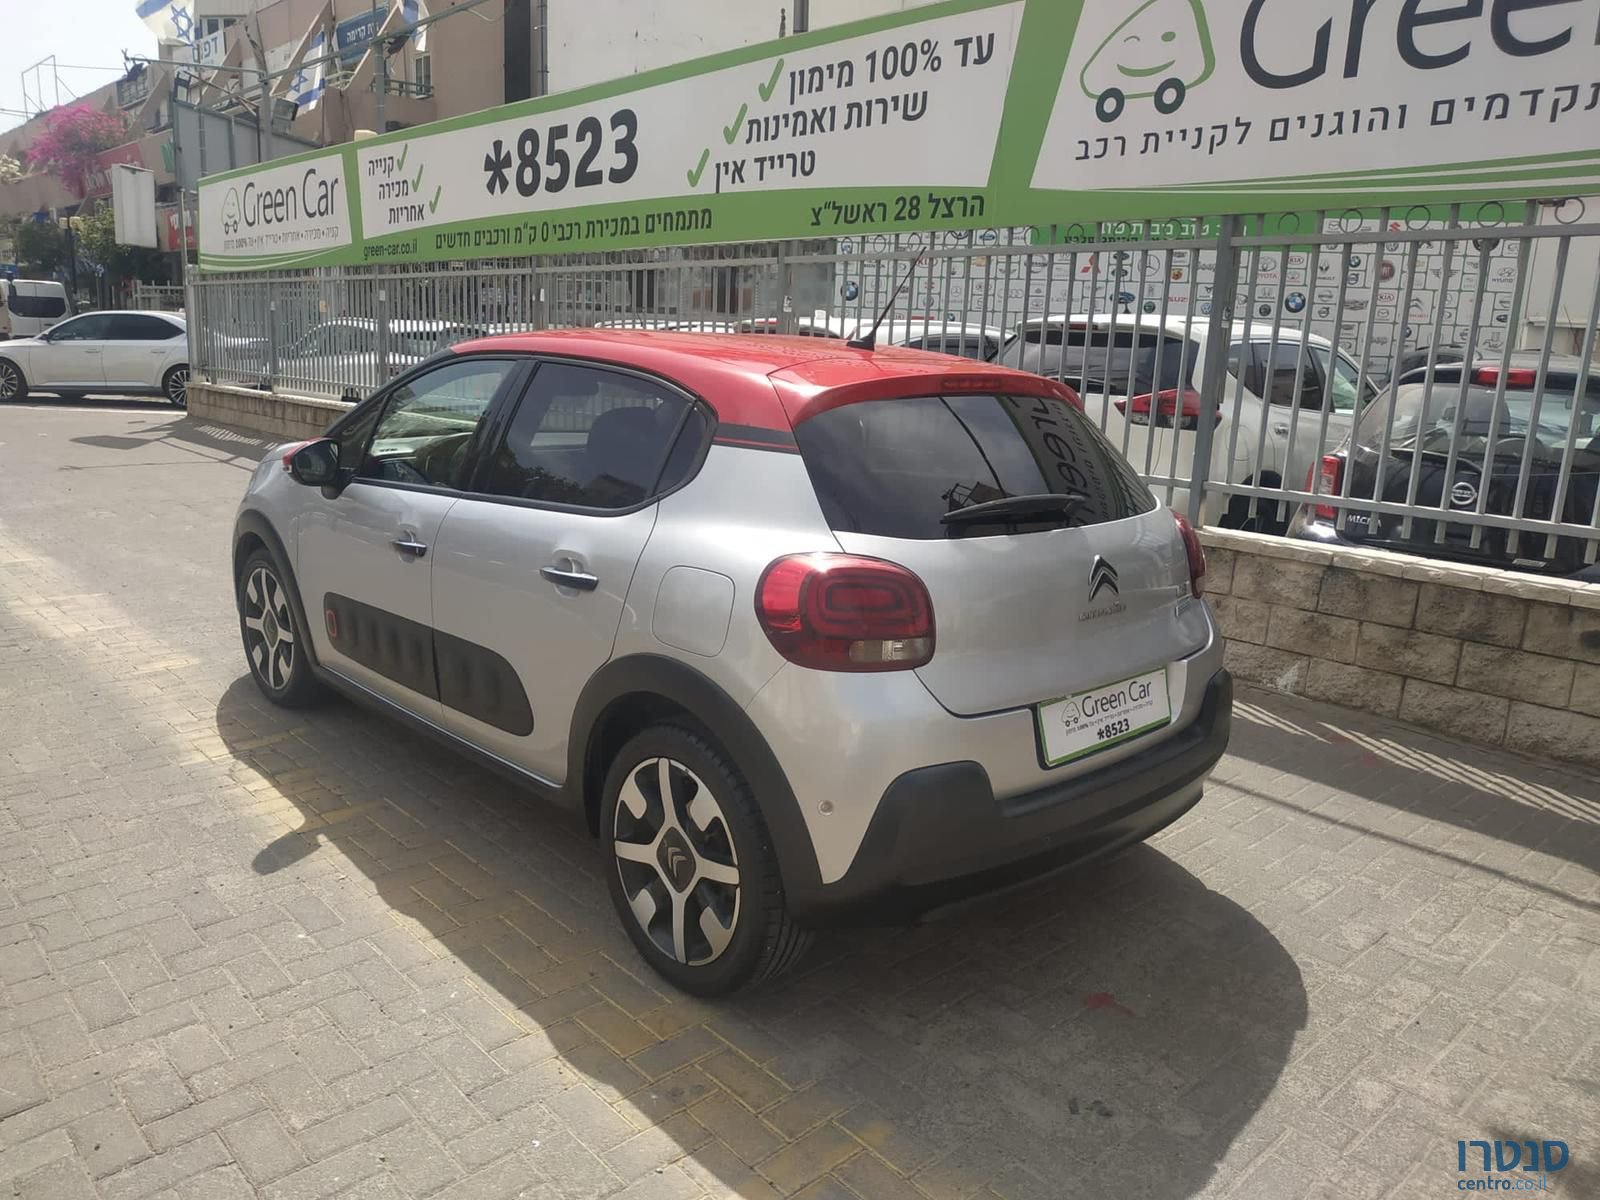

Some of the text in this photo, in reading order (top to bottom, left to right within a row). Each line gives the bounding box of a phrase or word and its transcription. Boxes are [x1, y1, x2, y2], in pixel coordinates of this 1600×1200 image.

[1240, 0, 1600, 89] Gree
[789, 33, 995, 105] עד 100% מימון
[745, 90, 928, 145] שירות ואמינות
[1269, 103, 1407, 141] והוגנים
[1075, 134, 1126, 161] רכב
[1140, 116, 1252, 154] לקניית
[368, 156, 394, 177] קנייה
[714, 150, 815, 194] טרייד אין
[243, 182, 297, 227] Green
[303, 168, 338, 218] Car
[378, 179, 409, 200] מכירה
[388, 203, 425, 225] אחריות
[894, 196, 921, 221] 28
[928, 194, 985, 219] הרצל
[541, 222, 549, 242] 0
[552, 221, 582, 242] רכבי
[585, 217, 640, 240] במכירת
[645, 208, 712, 233] מתמחים
[435, 230, 471, 249] חדשים
[473, 226, 511, 247] ורכבים
[363, 239, 418, 261] green-car.co.il
[1081, 694, 1127, 719] Green
[1128, 680, 1152, 699] Car
